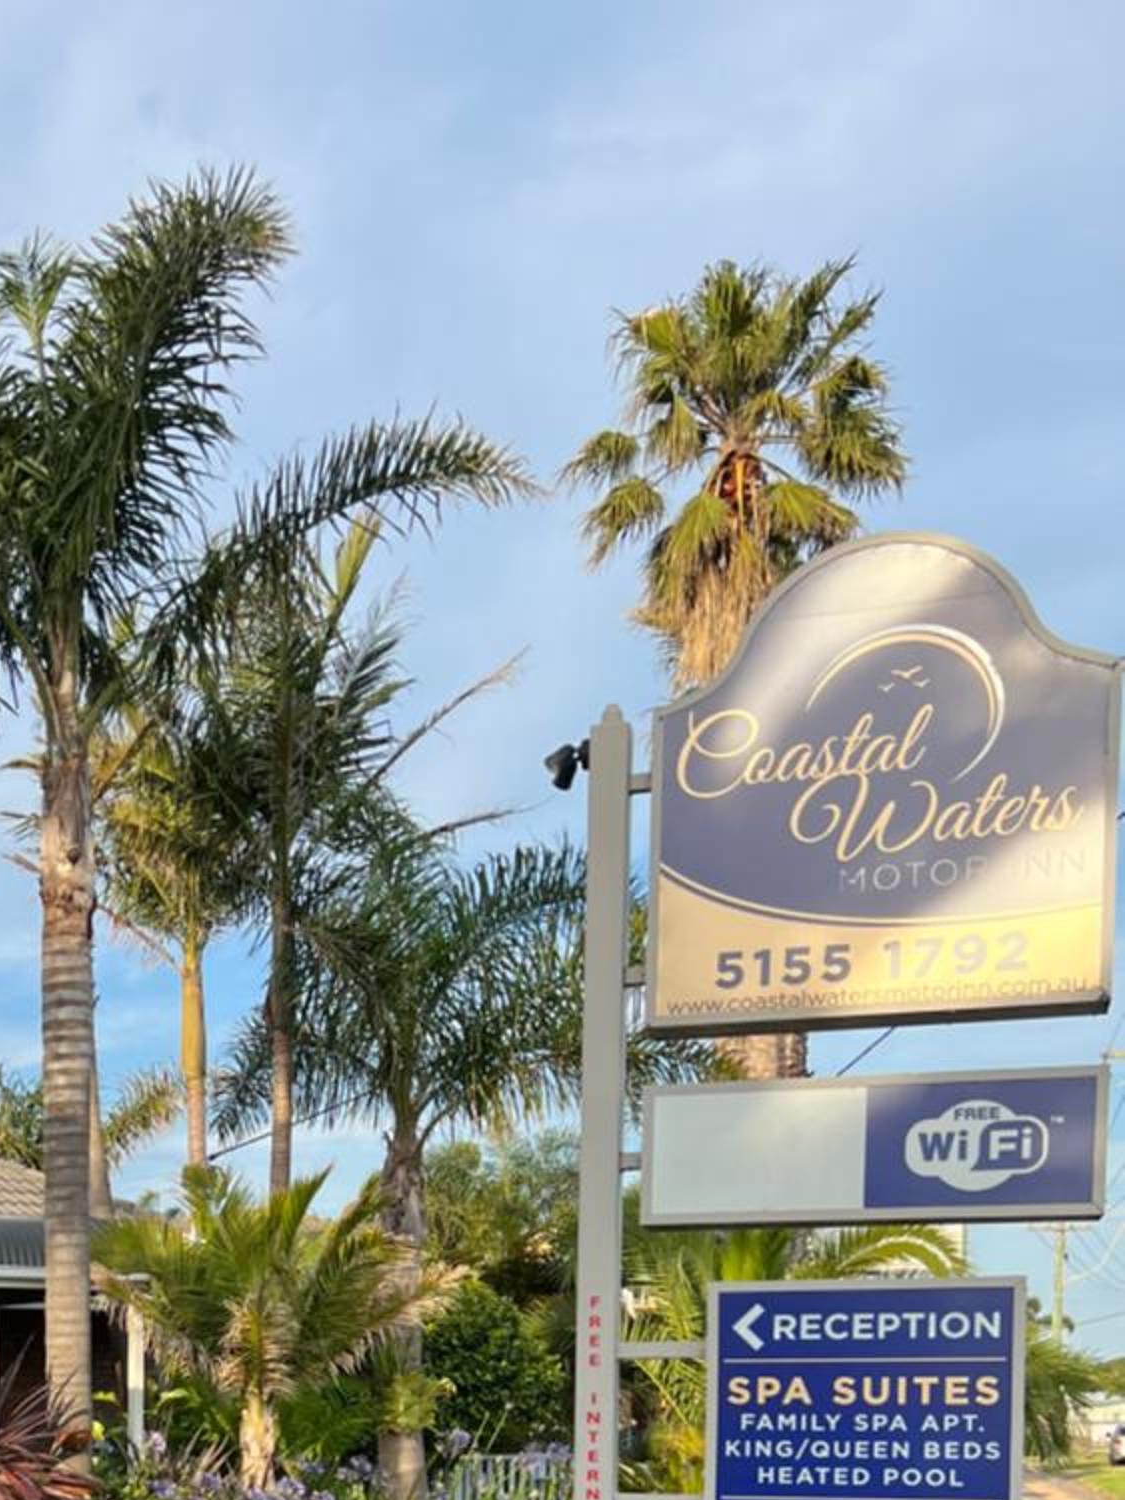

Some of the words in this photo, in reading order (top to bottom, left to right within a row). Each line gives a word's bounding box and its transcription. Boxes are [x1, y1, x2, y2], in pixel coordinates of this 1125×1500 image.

[678, 703, 934, 799] Coastal
[789, 772, 1083, 863] Waters
[715, 943, 852, 990] 5155
[883, 930, 1029, 980] 1792
[954, 1106, 1000, 1121] FREE
[588, 1295, 602, 1367] FREE
[773, 1311, 1002, 1341] RECEPTION
[727, 1375, 812, 1406] SPA
[832, 1375, 1001, 1406] SUITES
[739, 1413, 842, 1432] FAMILY
[853, 1413, 908, 1432] SPA
[920, 1413, 985, 1433] APT.
[724, 1438, 910, 1460] KING/QUEEN
[923, 1440, 1001, 1460] BEDS
[757, 1466, 871, 1486] HEATED
[882, 1467, 965, 1488] POOL
